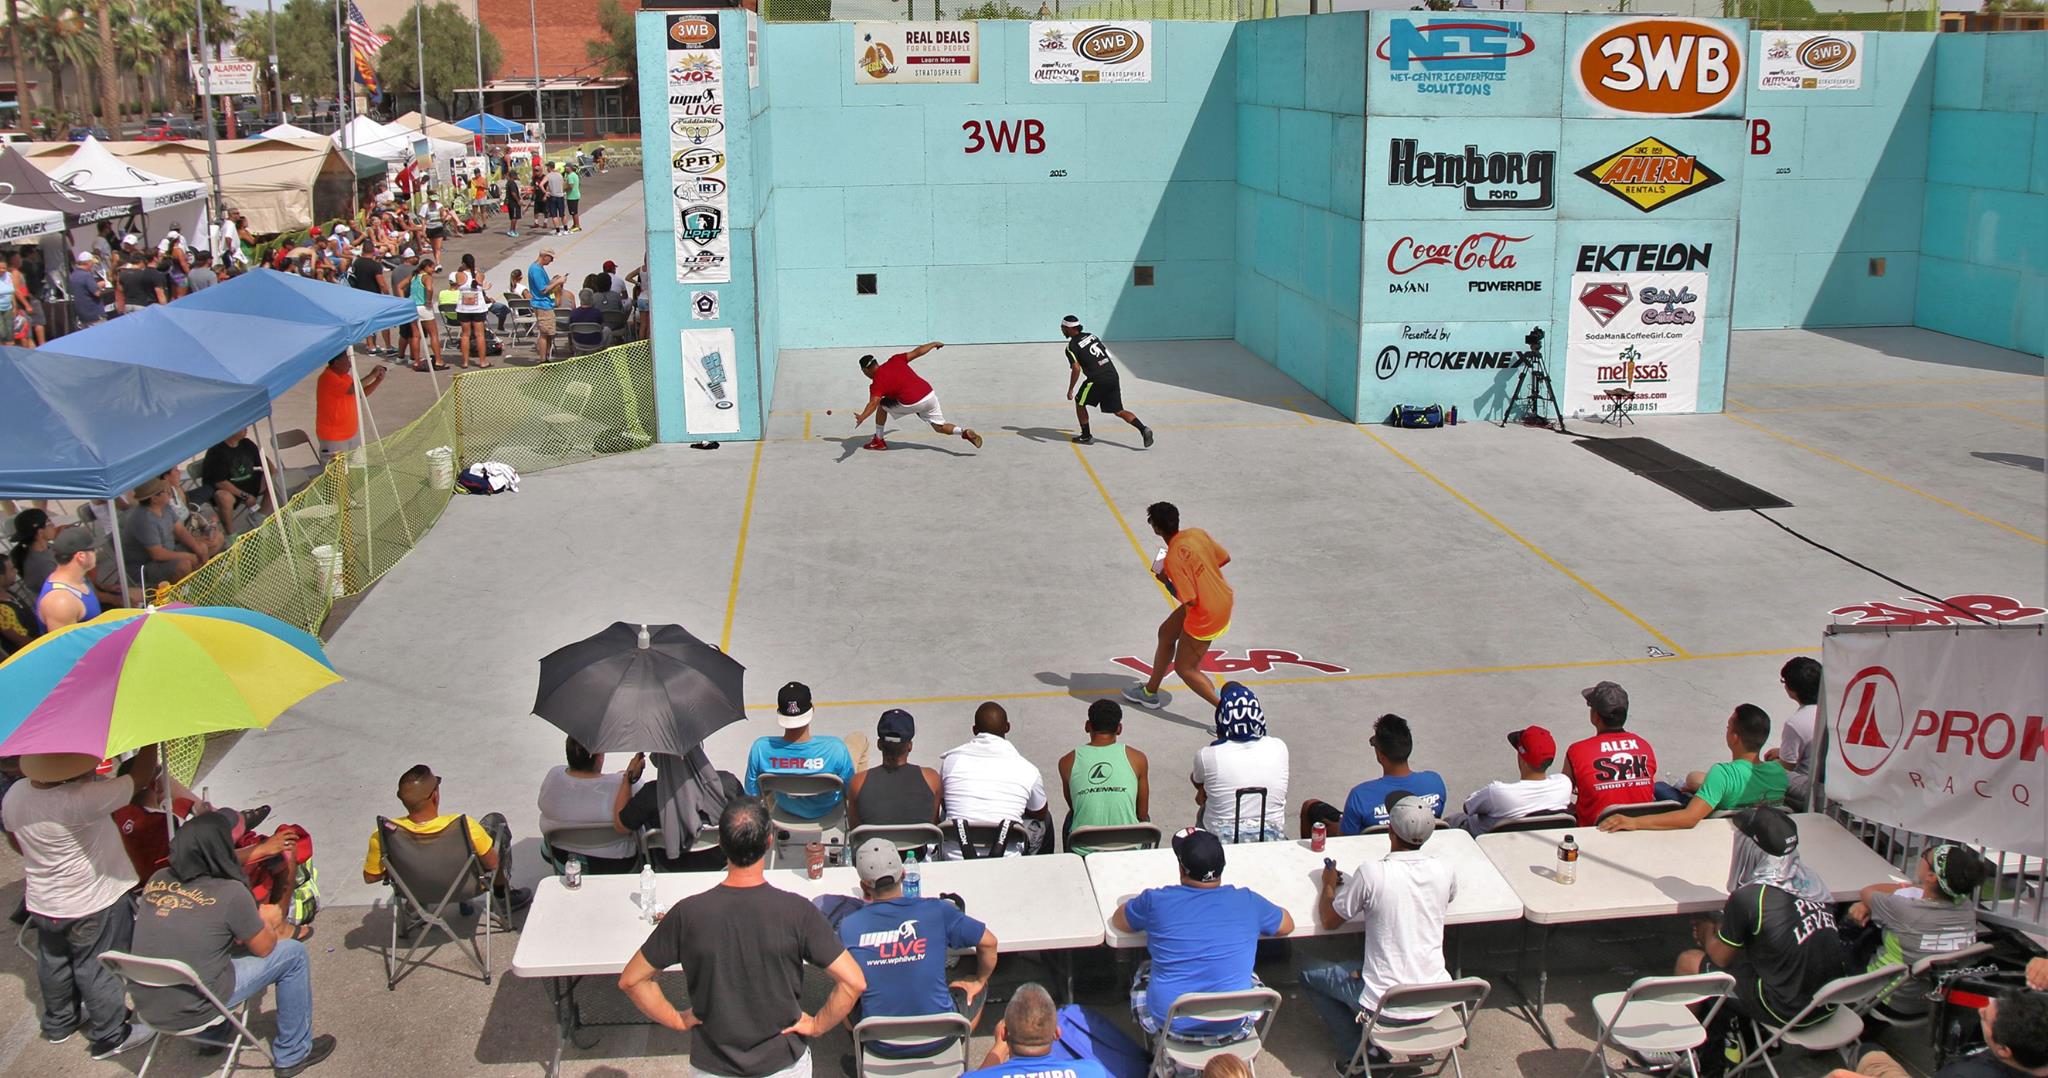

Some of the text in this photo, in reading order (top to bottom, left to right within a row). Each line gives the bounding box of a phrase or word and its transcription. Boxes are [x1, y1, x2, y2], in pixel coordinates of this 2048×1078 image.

[678, 24, 709, 37] 3WB
[906, 31, 970, 44] REAL DEALS
[1092, 34, 1126, 52] 3WB
[944, 44, 970, 52] PEOPLE
[1813, 44, 1842, 61] 3WB
[213, 64, 252, 73] ALARMCO
[1600, 33, 1731, 95] 3WB
[915, 69, 961, 77] STRATOSPHERE
[1034, 69, 1080, 79] OUTDOOR
[1417, 83, 1491, 96] SOLUTIONS
[685, 104, 722, 116] LIVE
[962, 119, 1047, 154] 3WB
[673, 153, 724, 169] CPRT
[1049, 169, 1068, 177] 2015
[1600, 155, 1697, 185] AHERN
[698, 183, 719, 192] IRT
[1625, 186, 1666, 194] RENTALS
[155, 190, 197, 206] PROKENNEX
[1489, 190, 1518, 199] FORD
[78, 204, 131, 223] PROKENNEX
[1576, 243, 1712, 272] EKTELON
[1389, 281, 1429, 294] DASANI
[1468, 281, 1542, 292] POWERADE
[1402, 325, 1451, 342] Presented by
[1585, 331, 1683, 341] SodaMan&CoffeeGirl.Com
[1404, 350, 1533, 370] PROKENNEX
[1601, 739, 1639, 752] ALEX
[1595, 783, 1626, 791] SHOOT
[880, 938, 928, 958] LIVE
[866, 953, 926, 966] www.wphlive.tv
